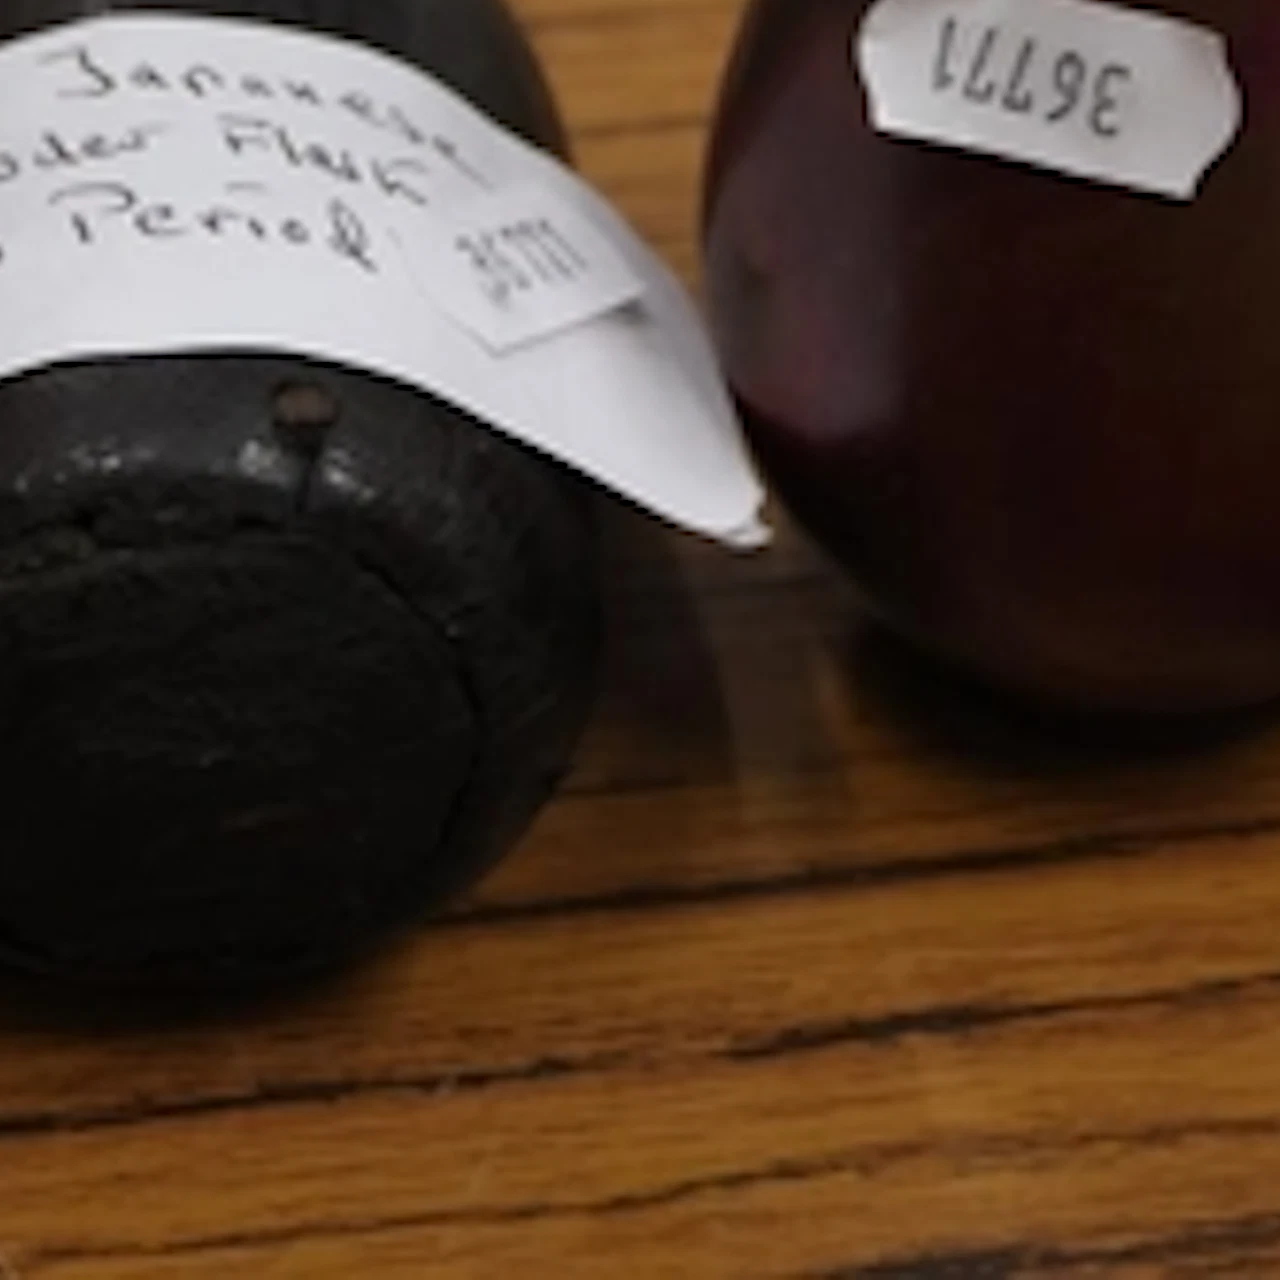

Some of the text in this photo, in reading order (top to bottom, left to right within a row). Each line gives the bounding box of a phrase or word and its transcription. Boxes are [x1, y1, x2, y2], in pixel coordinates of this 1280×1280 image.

[33, 45, 495, 192] Japanese
[928, 12, 1132, 138] 36771
[46, 182, 378, 274] Period
